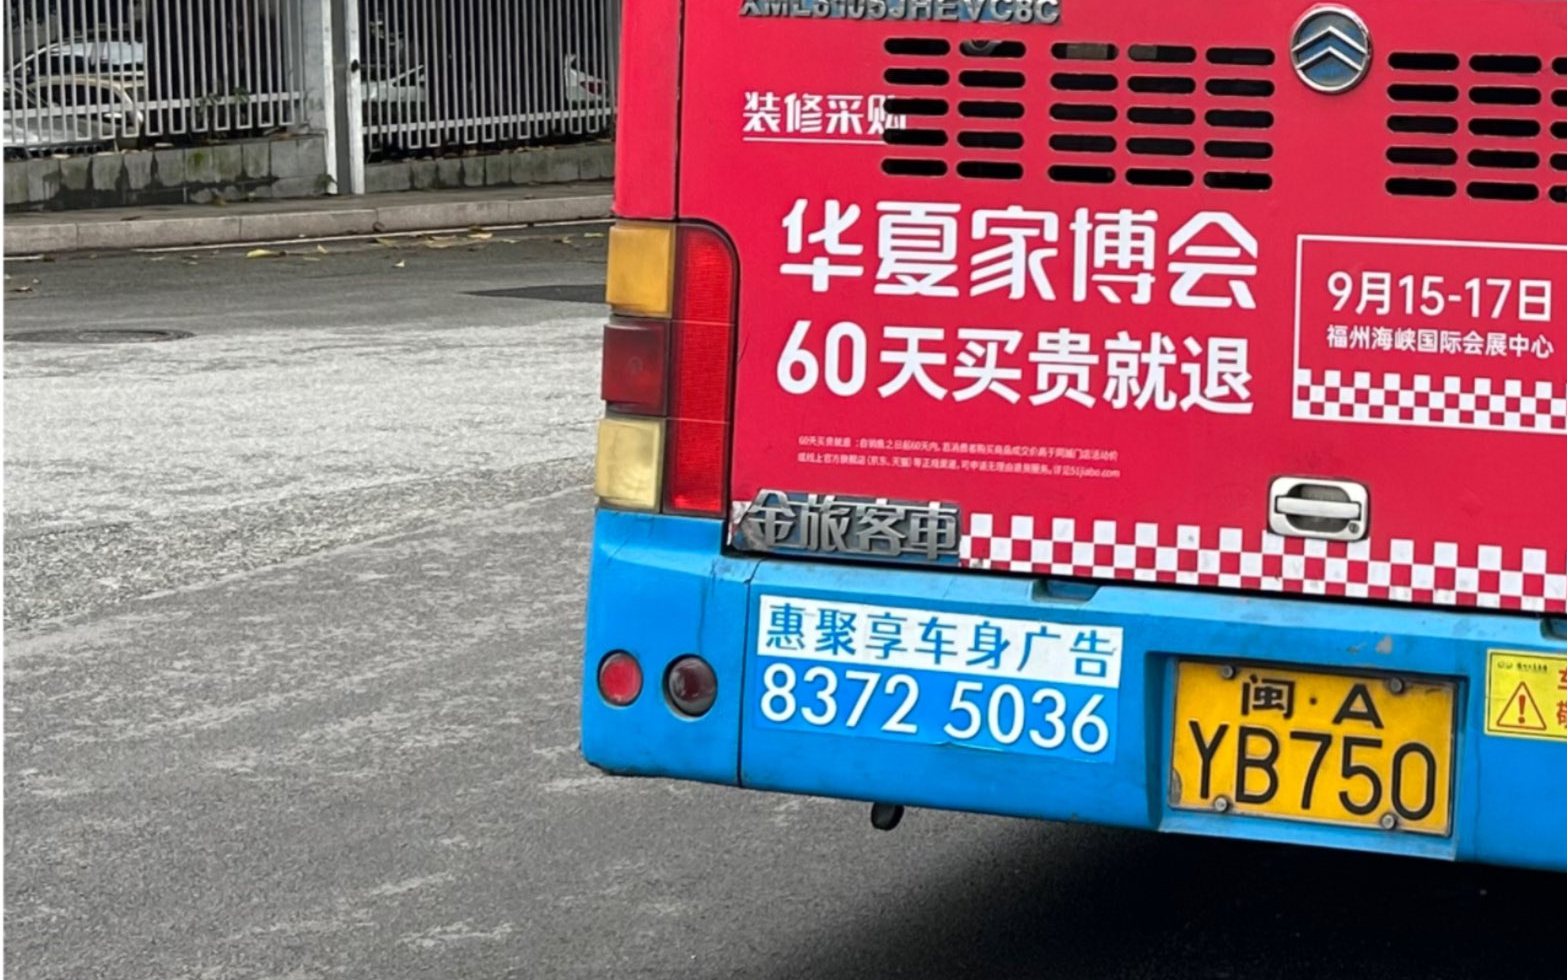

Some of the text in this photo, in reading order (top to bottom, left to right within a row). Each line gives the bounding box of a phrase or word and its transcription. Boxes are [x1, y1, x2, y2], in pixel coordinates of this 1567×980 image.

[779, 198, 1258, 310] 华夏家博会
[1326, 270, 1552, 322] 9月15-17日
[776, 319, 1255, 415] 60天买贵就退
[1326, 324, 1554, 359] 福州海峡国际会展中心
[765, 602, 1114, 678] 惠聚享车身广告
[760, 663, 1109, 754] 8372 5036
[1188, 720, 1438, 822] YB750
